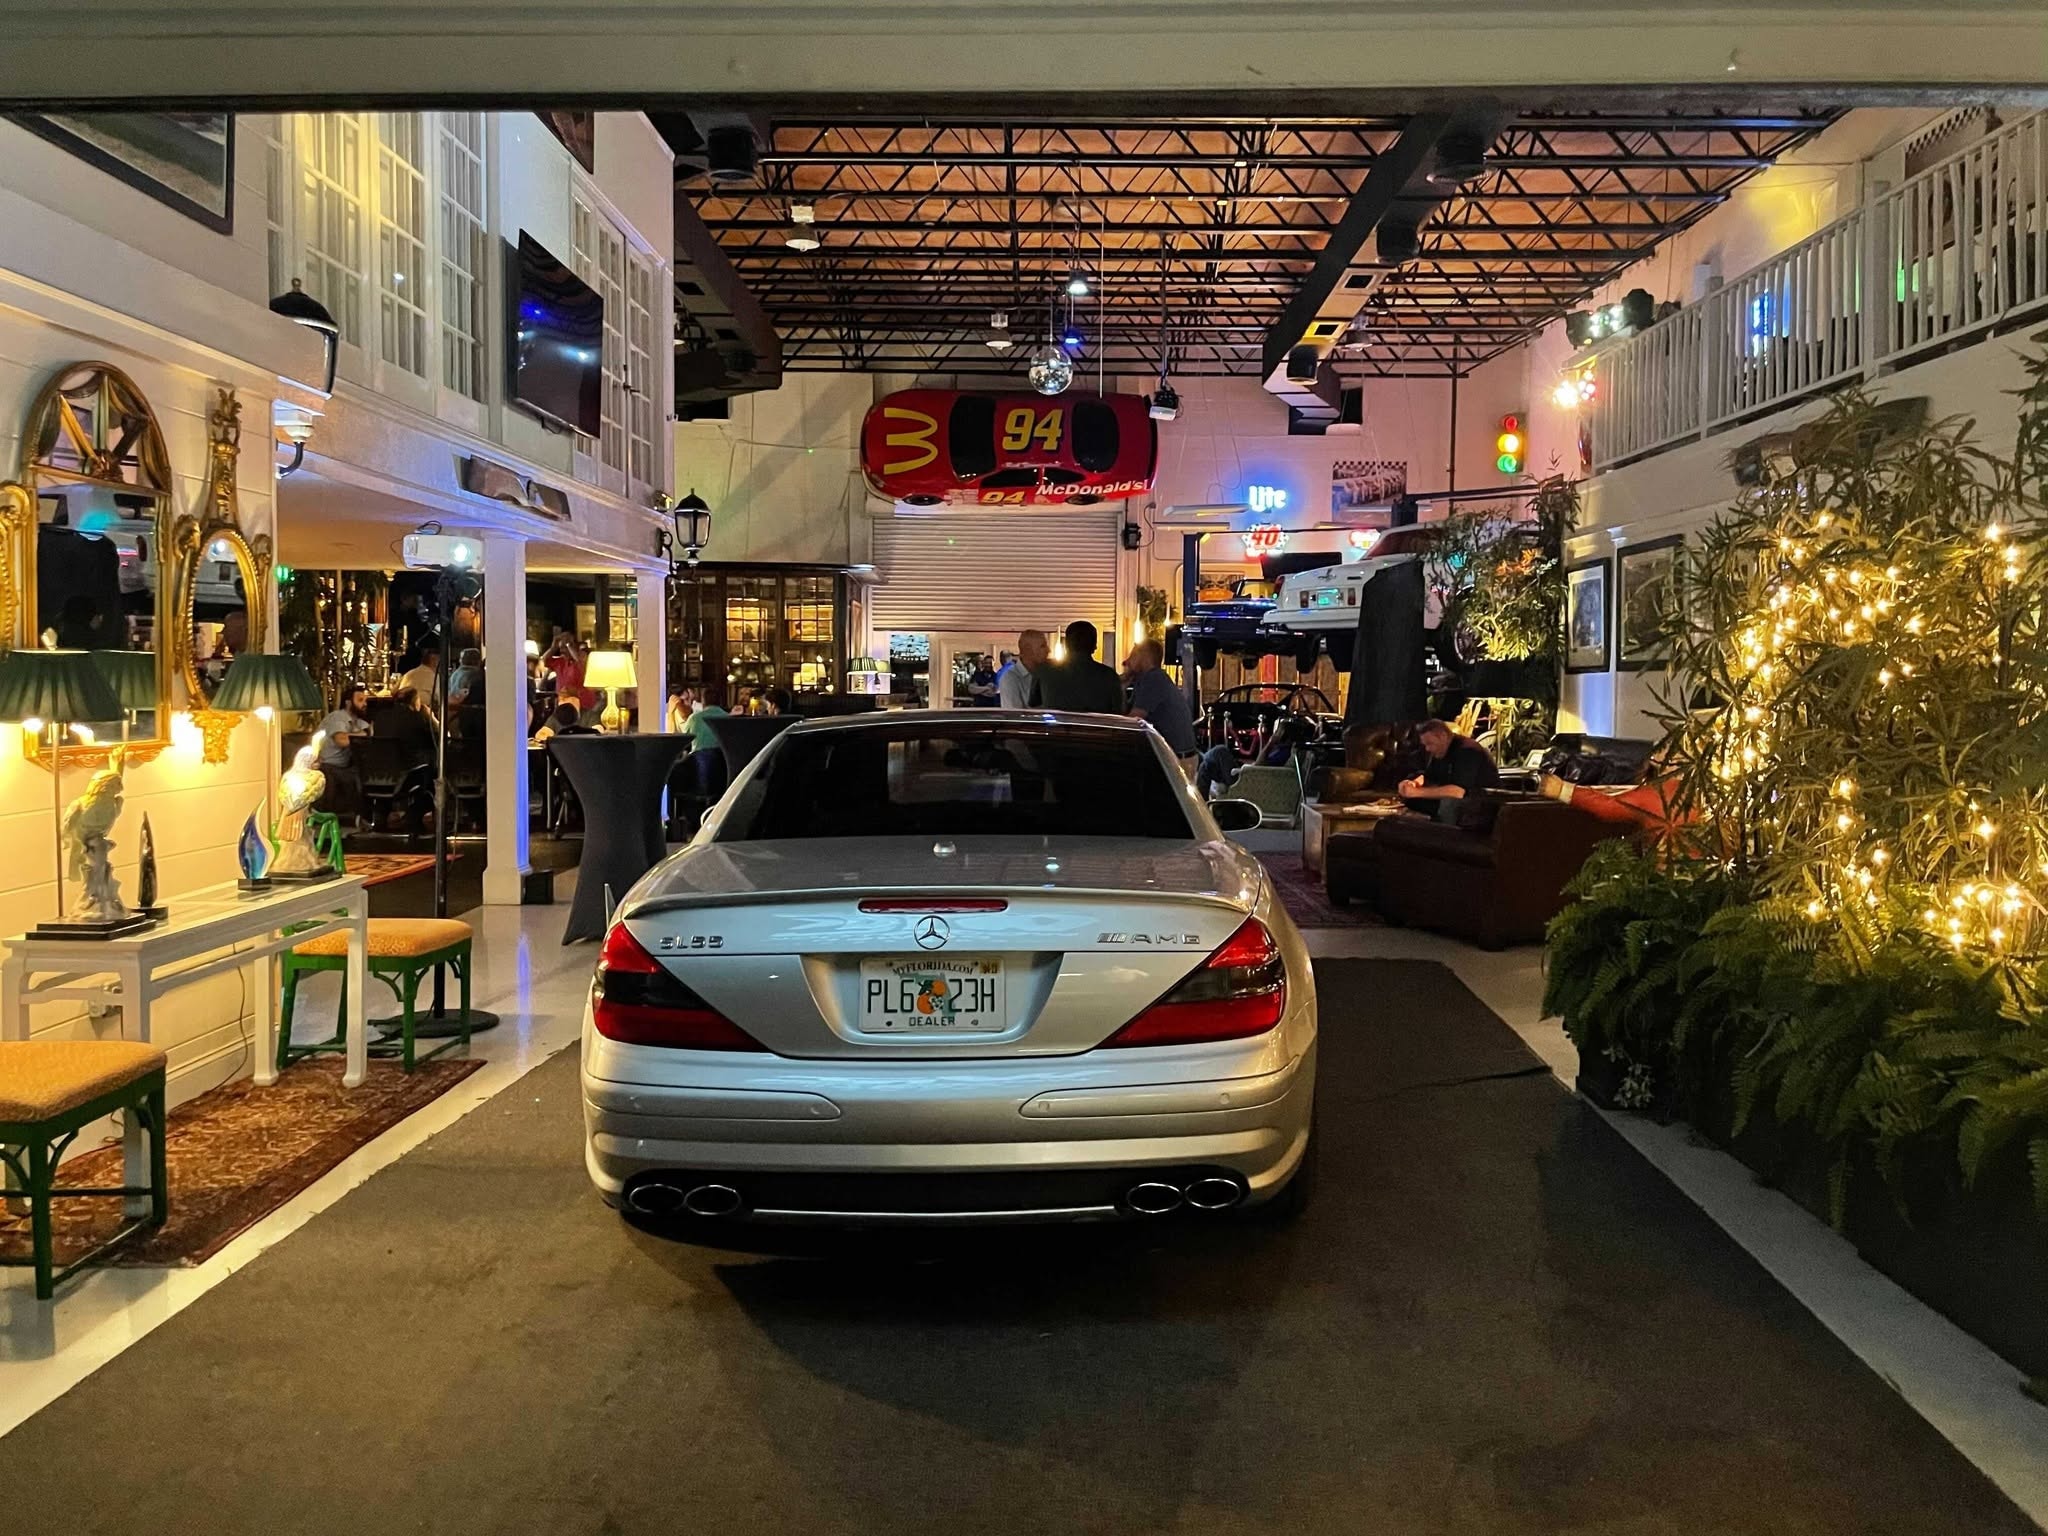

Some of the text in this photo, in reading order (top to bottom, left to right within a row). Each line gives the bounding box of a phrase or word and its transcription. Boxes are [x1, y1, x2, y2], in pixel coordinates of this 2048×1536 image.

[1002, 408, 1063, 451] 94
[1035, 480, 1144, 496] McDonald's
[981, 491, 1025, 504] 94
[1252, 526, 1280, 546] 40
[1130, 934, 1200, 944] AMG
[893, 961, 974, 976] MYFLORIDA.COM
[908, 1016, 956, 1027] DEALER
